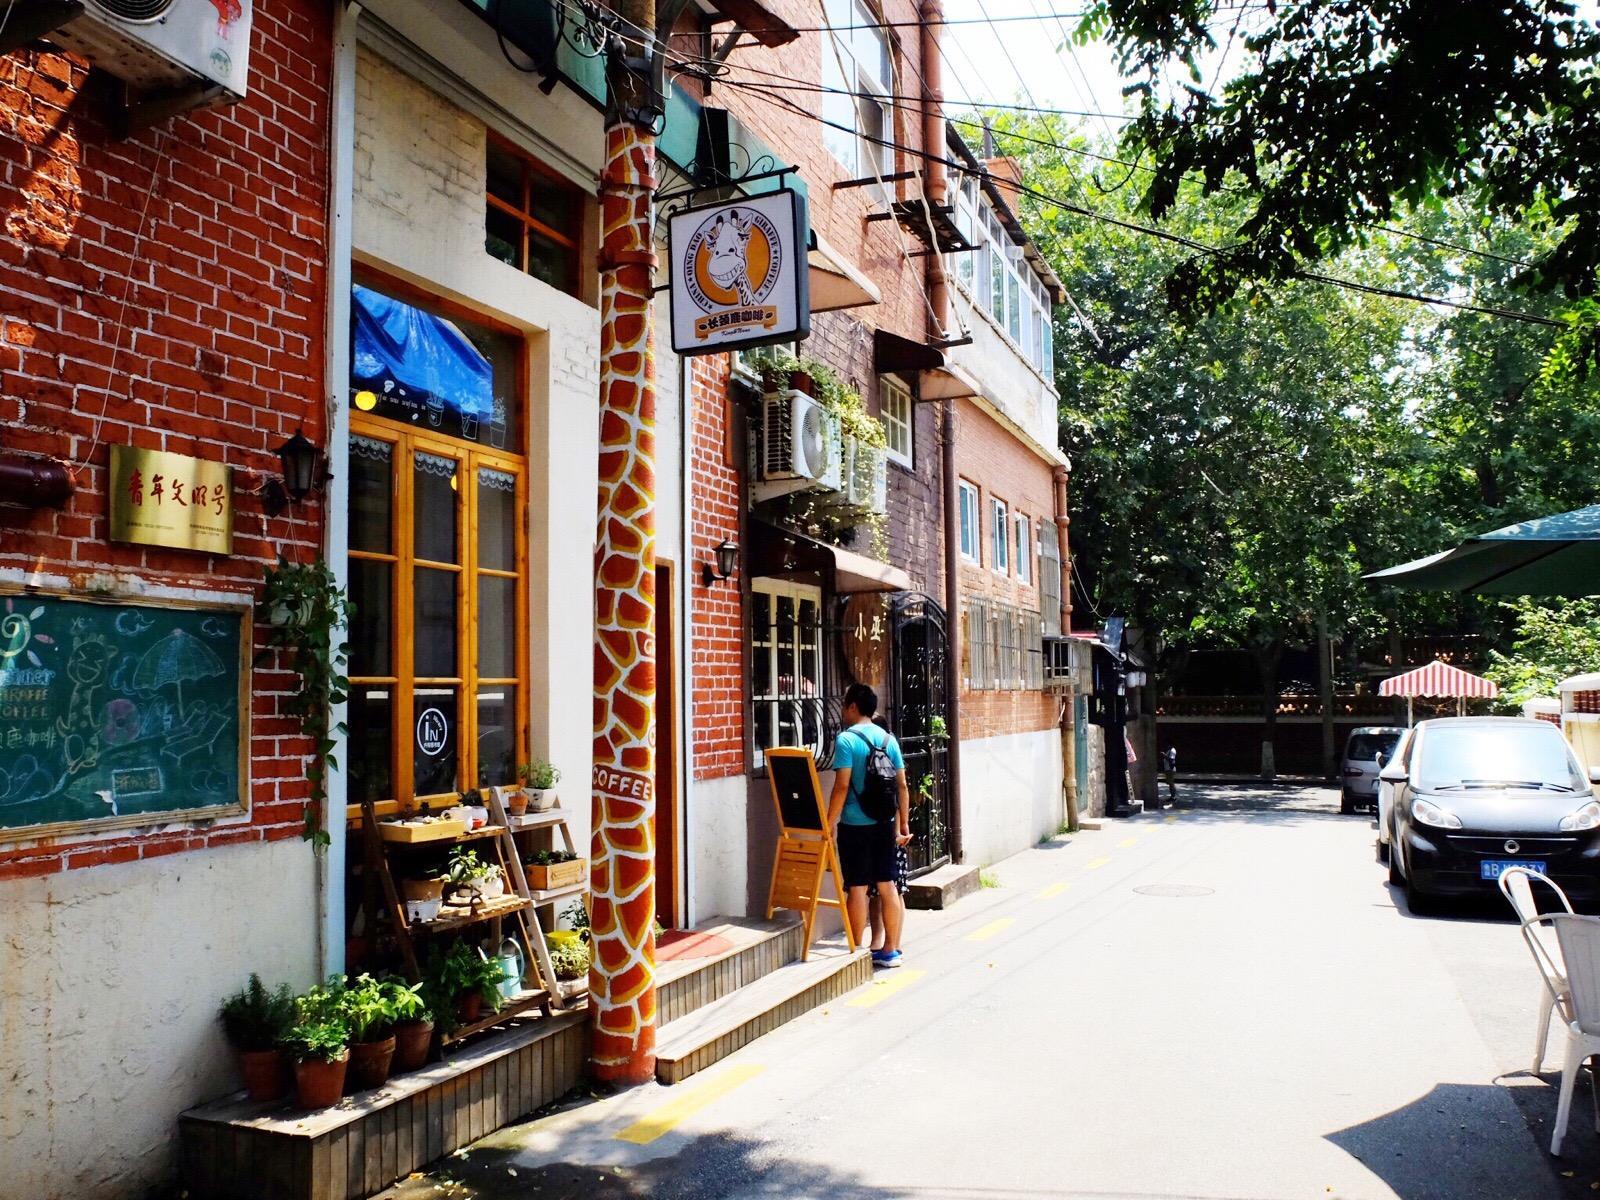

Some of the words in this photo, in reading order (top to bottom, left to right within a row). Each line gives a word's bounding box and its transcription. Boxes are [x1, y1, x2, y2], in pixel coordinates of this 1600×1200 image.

[690, 232, 703, 251] DAO
[754, 215, 778, 248] GIRAFFE
[763, 255, 779, 291] COFFEE
[689, 282, 709, 309] CHINA
[707, 309, 764, 329] 长颈鹿咖啡
[127, 467, 225, 516] 青年文明号
[592, 765, 652, 800] COFFEE
